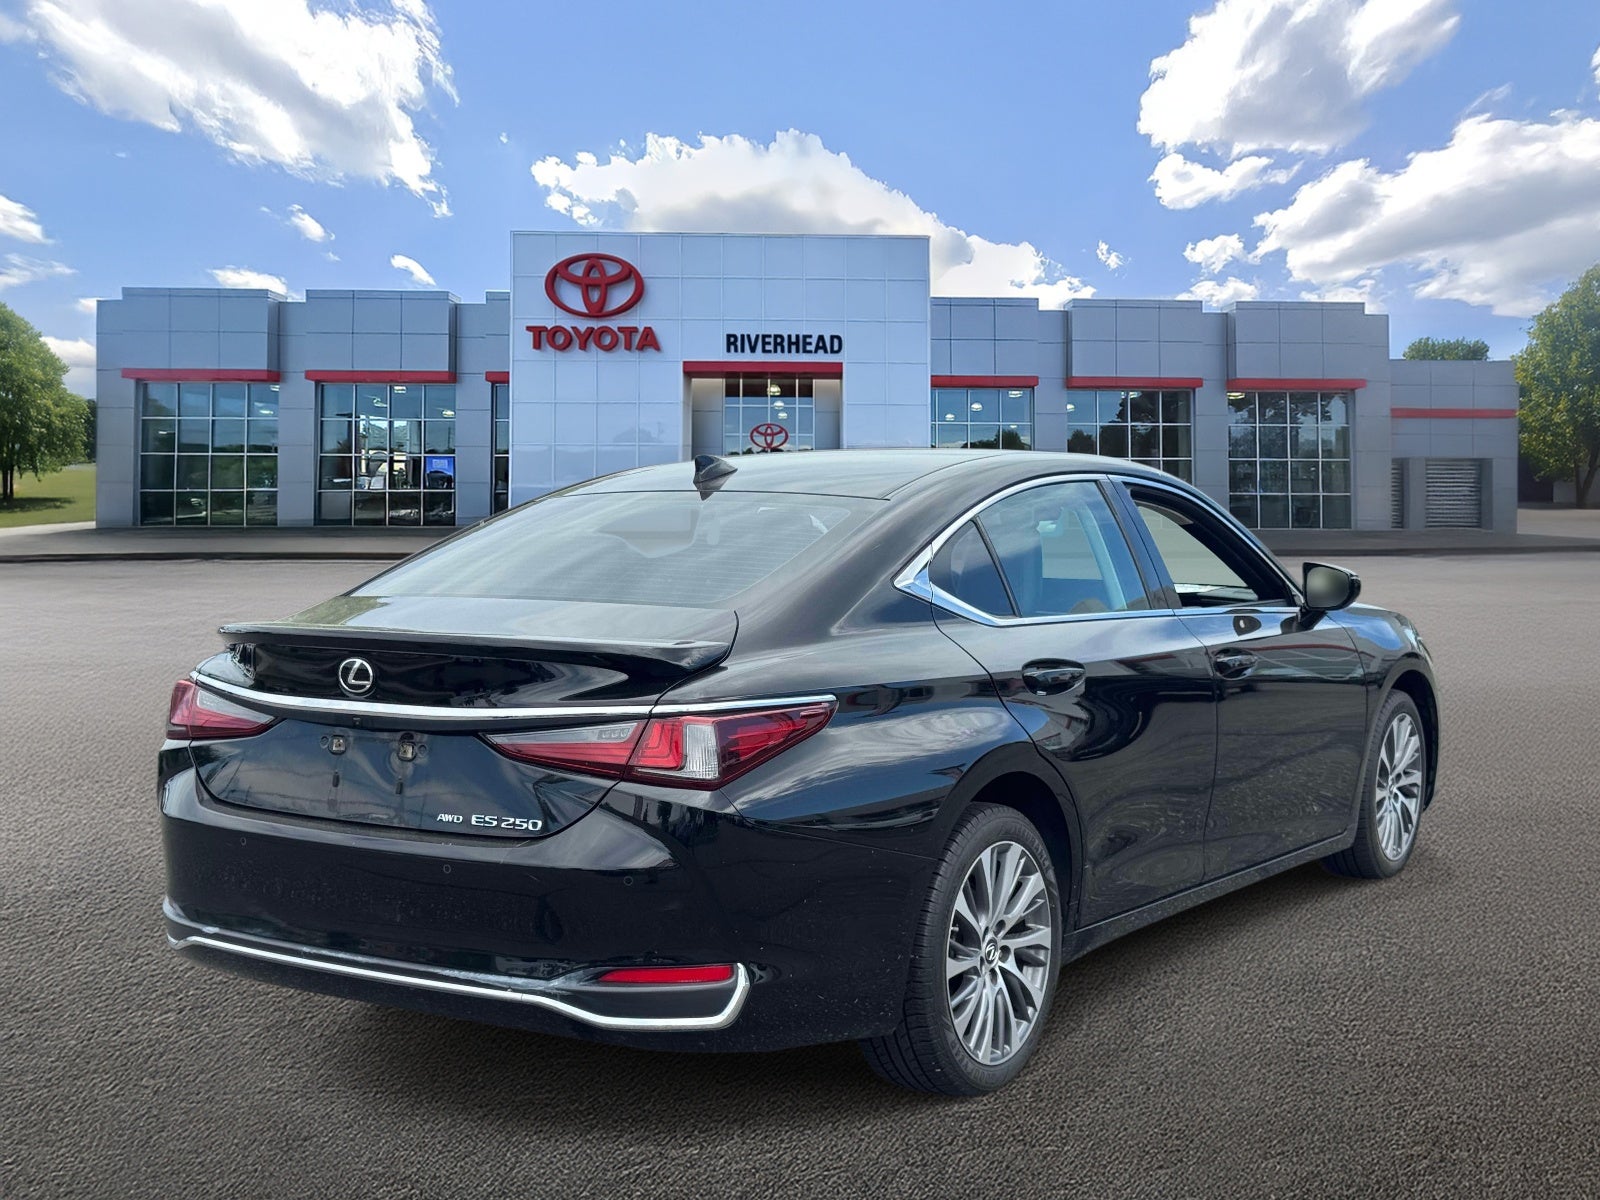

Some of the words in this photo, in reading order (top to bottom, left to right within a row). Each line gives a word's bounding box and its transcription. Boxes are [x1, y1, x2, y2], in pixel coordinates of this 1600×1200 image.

[526, 325, 661, 352] TOYOTA
[726, 333, 843, 354] RIVERHEAD
[437, 813, 463, 823] AWD
[471, 814, 498, 827] ES
[501, 817, 542, 831] 250
